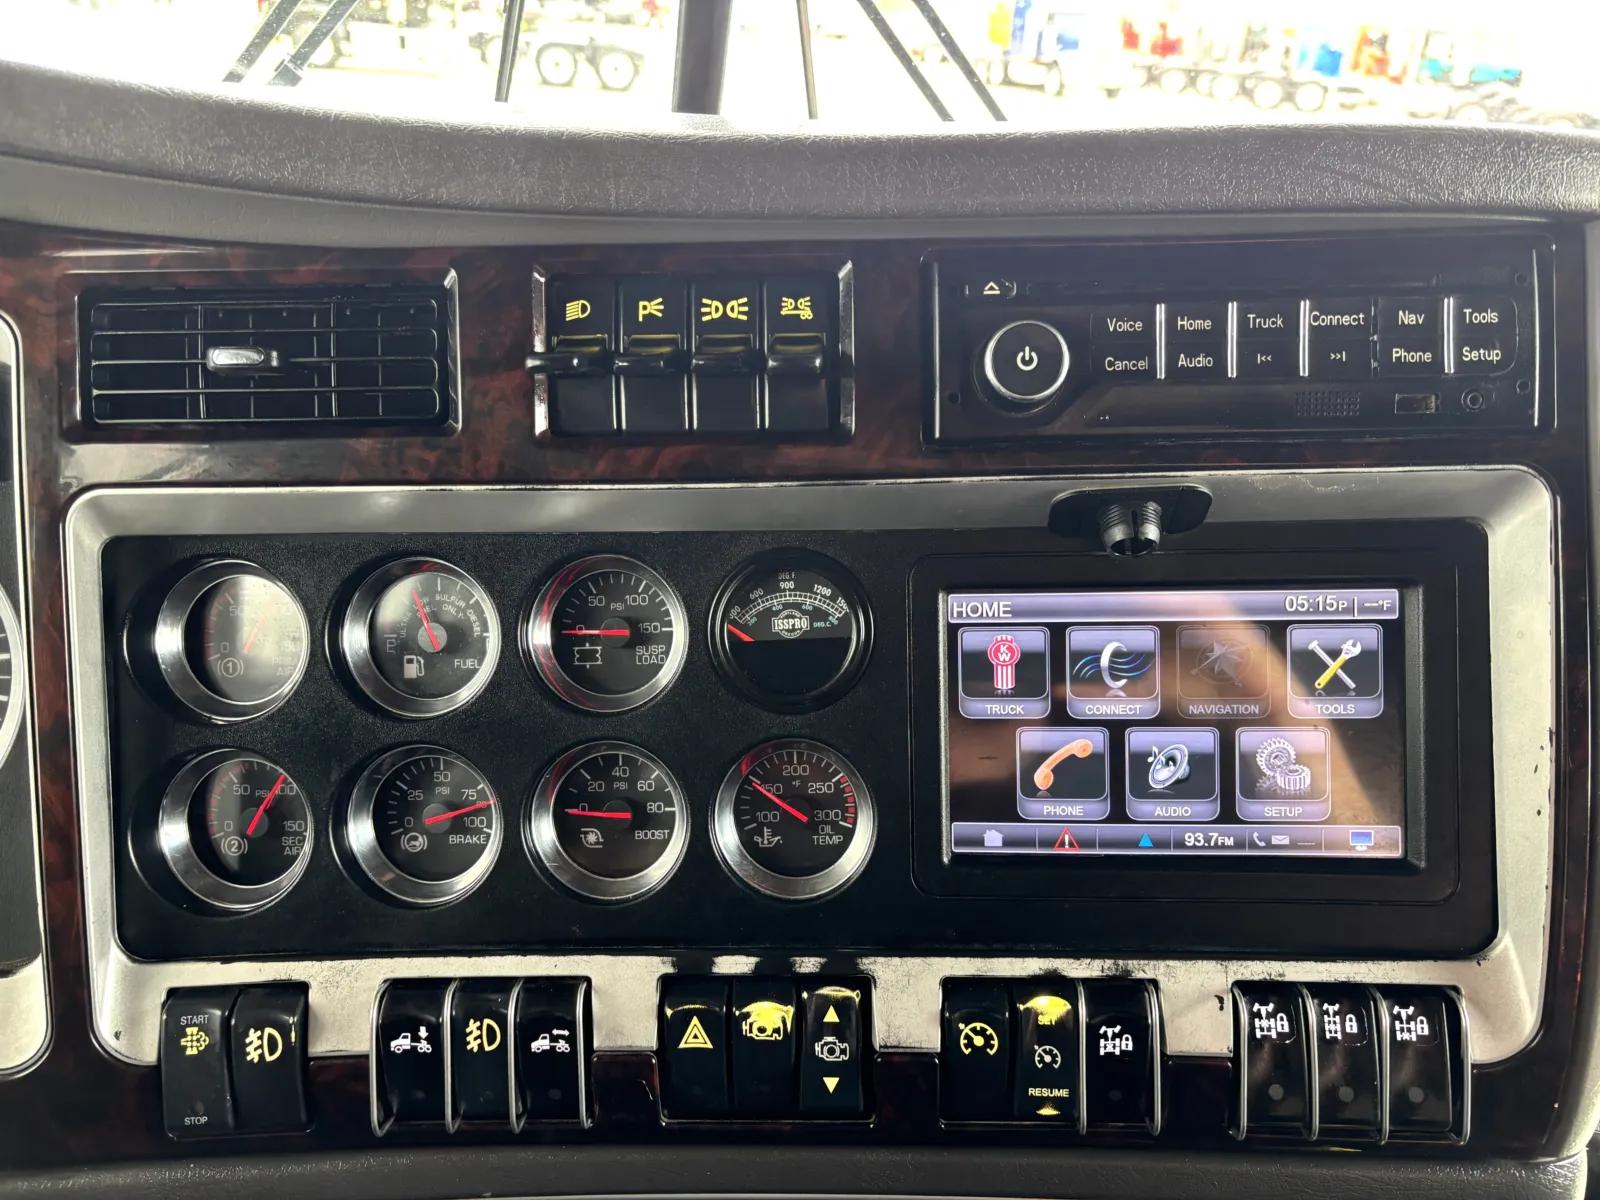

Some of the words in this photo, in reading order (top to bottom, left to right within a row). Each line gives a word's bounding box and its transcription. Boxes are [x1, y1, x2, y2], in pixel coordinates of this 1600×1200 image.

[1247, 313, 1284, 329] Truck
[1310, 311, 1365, 326] Connect
[1398, 310, 1424, 325] Nav
[1463, 308, 1499, 324] Tools
[1107, 317, 1143, 332] Voice
[1177, 316, 1212, 331] Home
[1177, 353, 1214, 368] Audio
[1392, 348, 1432, 363] Phone
[1462, 347, 1501, 364] Setup
[1105, 355, 1148, 371] Cancel
[779, 581, 795, 589] 900
[814, 584, 832, 597] 1200
[749, 587, 764, 600] 600
[588, 595, 605, 607] 50
[624, 594, 649, 606] 100
[610, 603, 625, 611] PSI
[952, 601, 1012, 618] HOME
[639, 622, 661, 634] 150
[774, 618, 808, 630] ISSPRO
[220, 641, 230, 653] 0
[635, 645, 666, 655] SUSP
[454, 658, 481, 669] FUEL
[635, 655, 666, 665] LOAD
[985, 704, 1024, 715] TRUCK
[1085, 704, 1142, 715] CONNECT
[1188, 703, 1259, 715] NAVIGATION
[1315, 703, 1355, 715] TOOLS
[611, 766, 629, 778] 40
[782, 764, 810, 776] 200
[433, 771, 451, 782] 50
[232, 784, 251, 795] 50
[435, 787, 450, 795] PSI
[587, 781, 605, 792] 20
[613, 782, 628, 790] PSI
[637, 780, 655, 792] 60
[807, 782, 834, 794] 250
[407, 789, 424, 801] 25
[460, 789, 477, 800] 75
[646, 802, 664, 813] 80
[1043, 805, 1084, 816] PHONE
[1154, 805, 1191, 817] AUDIO
[1264, 805, 1303, 817] SETUP
[756, 811, 780, 822] 100
[813, 809, 842, 821] 300
[224, 820, 233, 832] 0
[282, 820, 305, 832] 150
[404, 816, 414, 828] 0
[463, 816, 487, 828] 100
[635, 830, 670, 840] BOOST
[818, 825, 835, 834] OIL
[281, 836, 303, 846] SEC
[449, 834, 487, 845] BRAKE
[812, 835, 844, 845] TEMP
[283, 846, 302, 856] AIR
[180, 1015, 208, 1025] START
[1028, 1087, 1070, 1097] RESUME
[184, 1116, 208, 1126] STOP
